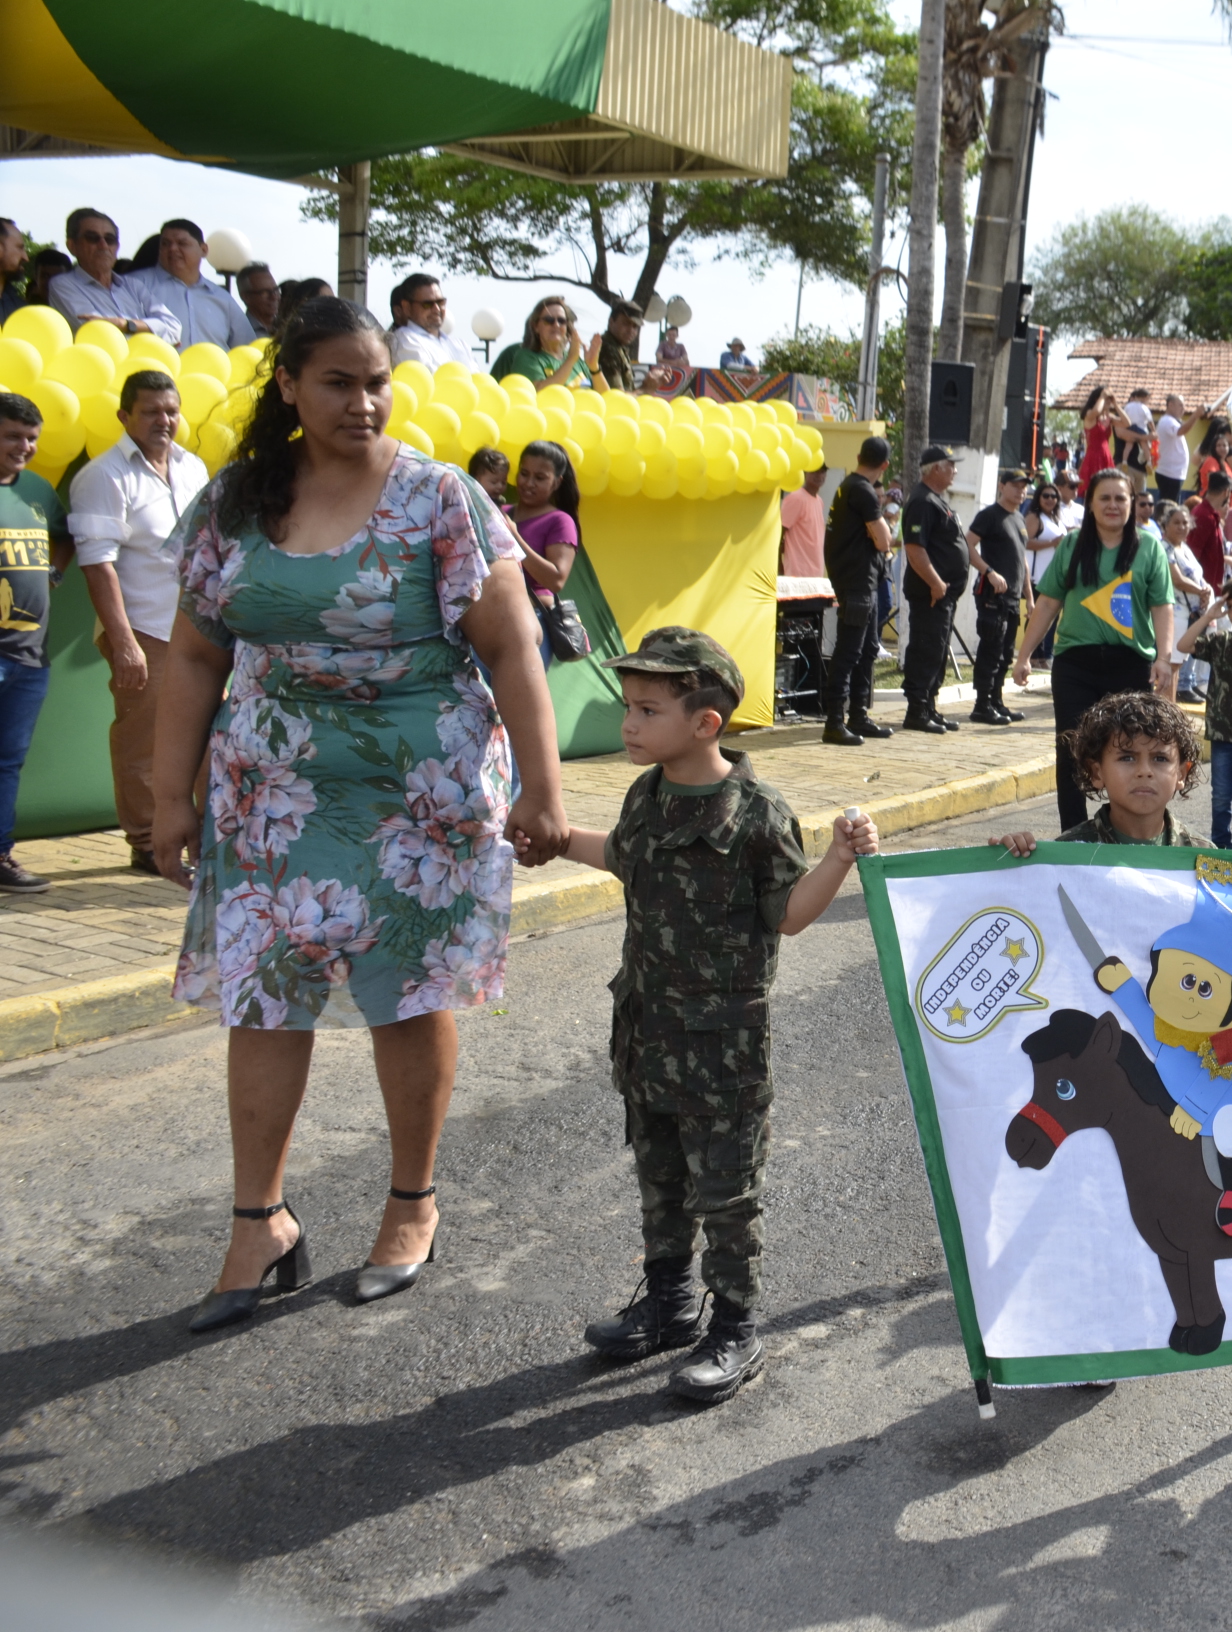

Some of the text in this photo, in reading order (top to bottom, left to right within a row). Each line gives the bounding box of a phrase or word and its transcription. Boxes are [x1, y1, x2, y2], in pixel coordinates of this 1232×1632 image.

[923, 917, 1010, 1014] INDEPENDÊNCIA
[971, 968, 991, 991] OU
[974, 968, 1020, 1021] MORTE!
